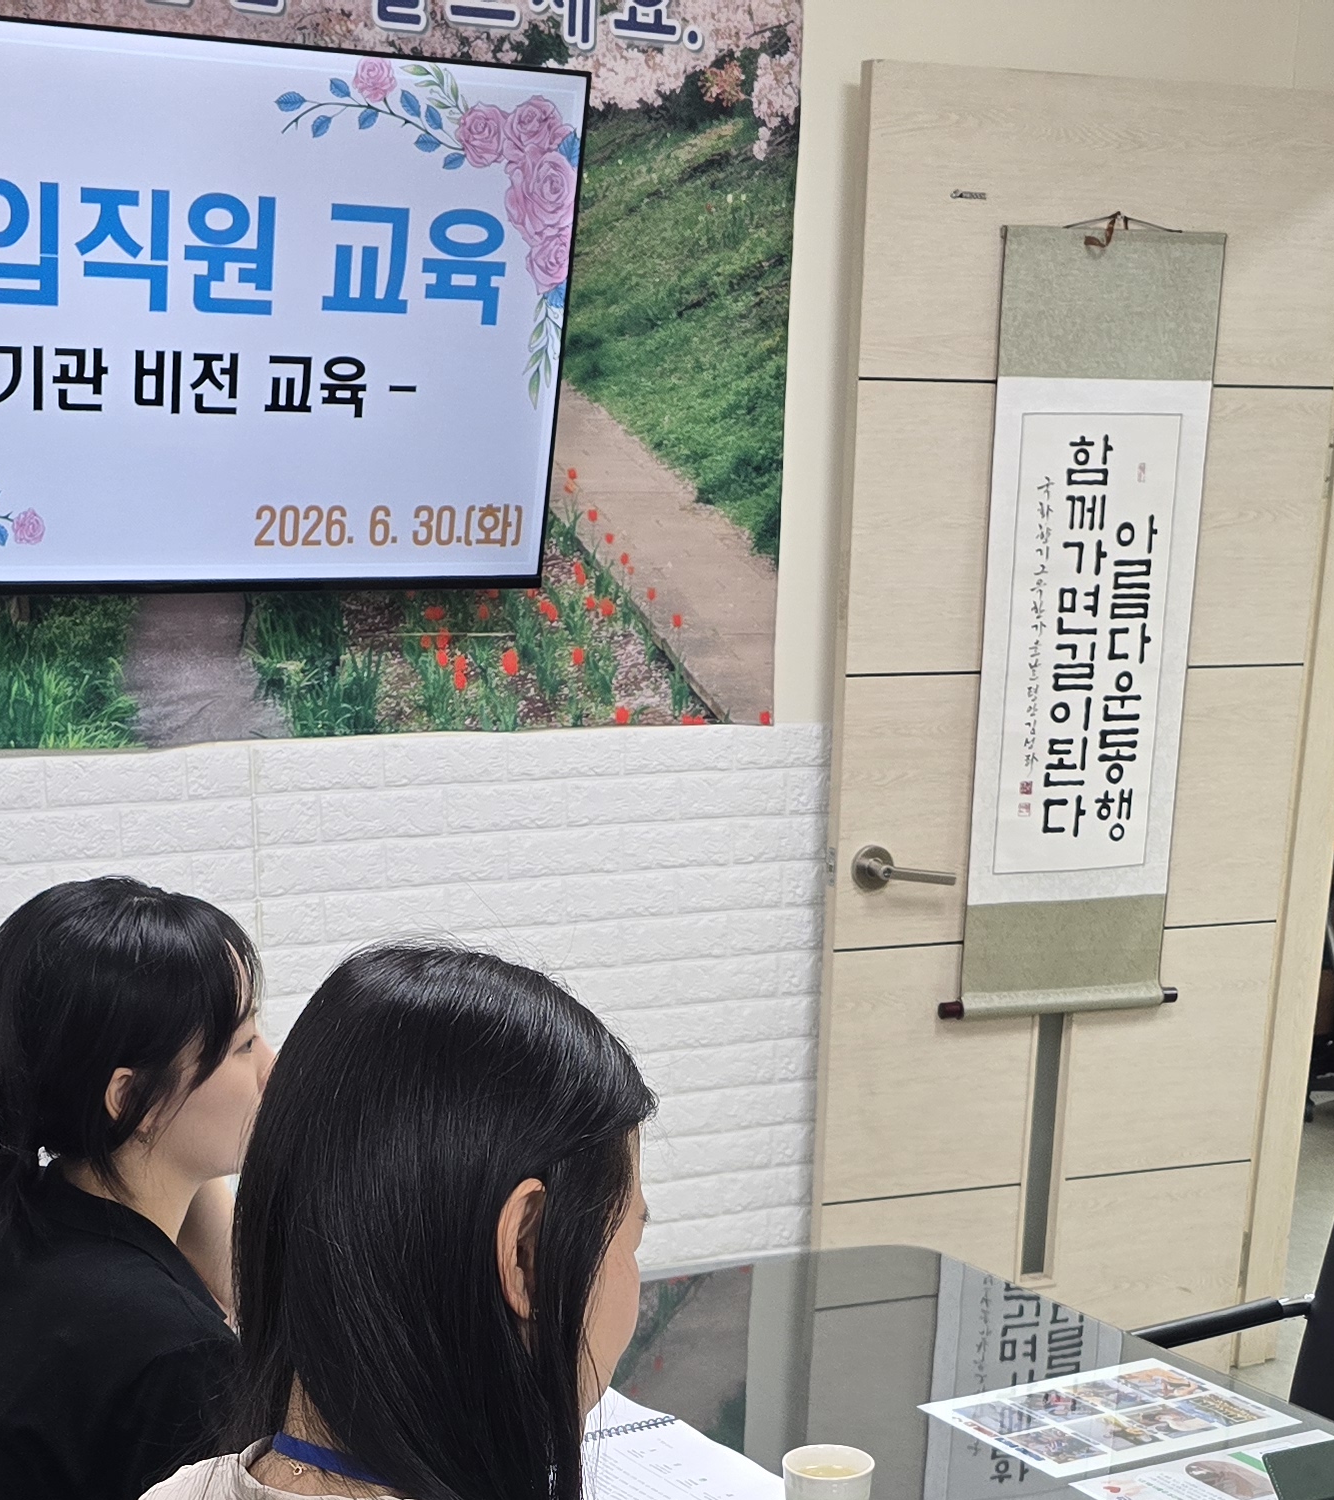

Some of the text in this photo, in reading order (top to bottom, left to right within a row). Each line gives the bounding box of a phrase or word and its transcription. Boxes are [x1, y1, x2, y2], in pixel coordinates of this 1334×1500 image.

[321, 203, 506, 326] 교육
[134, 349, 239, 415] 비전
[264, 355, 367, 418] 교육
[254, 503, 523, 547] 2026. 6. 30.(화)
